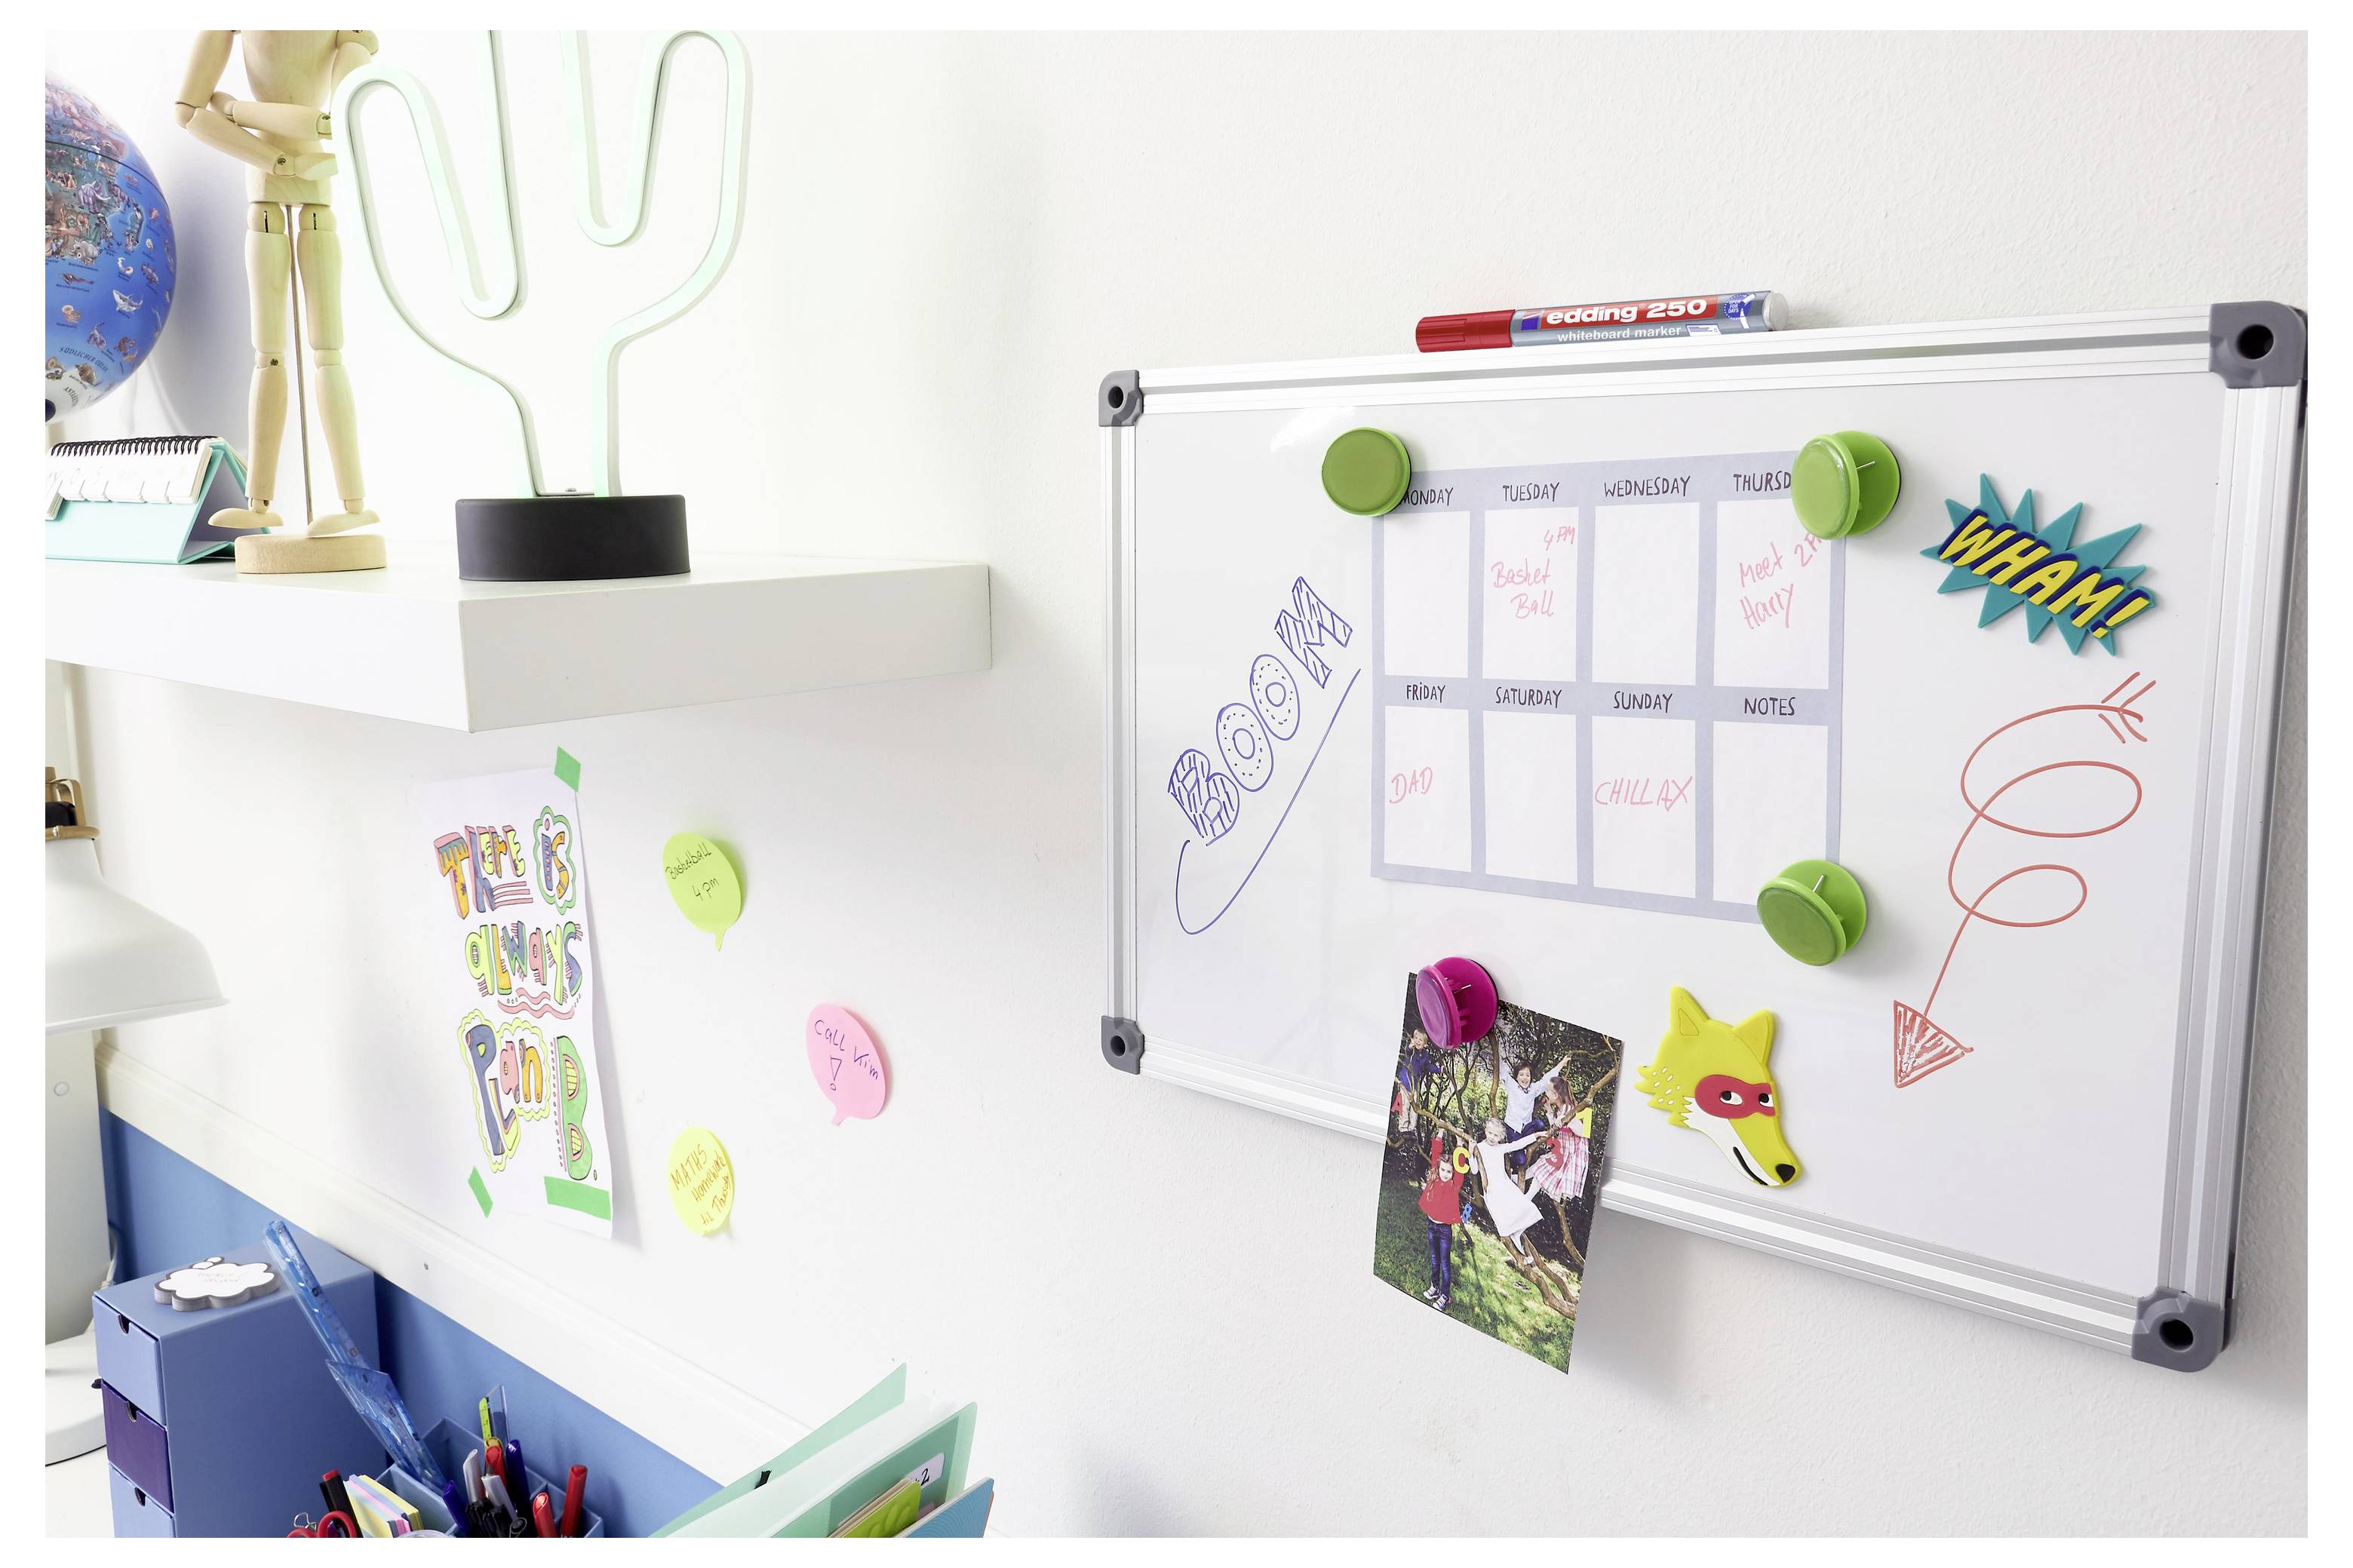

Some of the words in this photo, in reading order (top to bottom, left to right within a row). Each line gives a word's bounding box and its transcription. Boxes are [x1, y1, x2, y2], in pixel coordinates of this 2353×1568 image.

[1646, 299, 1708, 320] 250
[1557, 329, 1631, 342] whiteboard
[1634, 325, 1682, 338] marker
[1502, 482, 1560, 502] TUESDAY
[1604, 475, 1691, 498] WEDNESDAY
[1733, 471, 1792, 492] THURSD
[1544, 529, 1553, 551] 4
[1556, 526, 1576, 545] PM
[1491, 558, 1551, 588] Basket
[1937, 508, 2150, 639] WHAM!
[1510, 591, 1554, 619] Ball
[1740, 584, 1794, 630] Harry
[1495, 686, 1562, 707] SATURDAY
[1613, 691, 1673, 714] SUNDAY
[1743, 696, 1796, 716] NOTES
[1168, 576, 1353, 845] BOOM
[1389, 766, 1433, 805] DAD
[665, 842, 712, 880] Basketball
[692, 884, 704, 901] 4
[670, 1143, 707, 1191] MATHS
[1452, 1146, 1471, 1174] C
